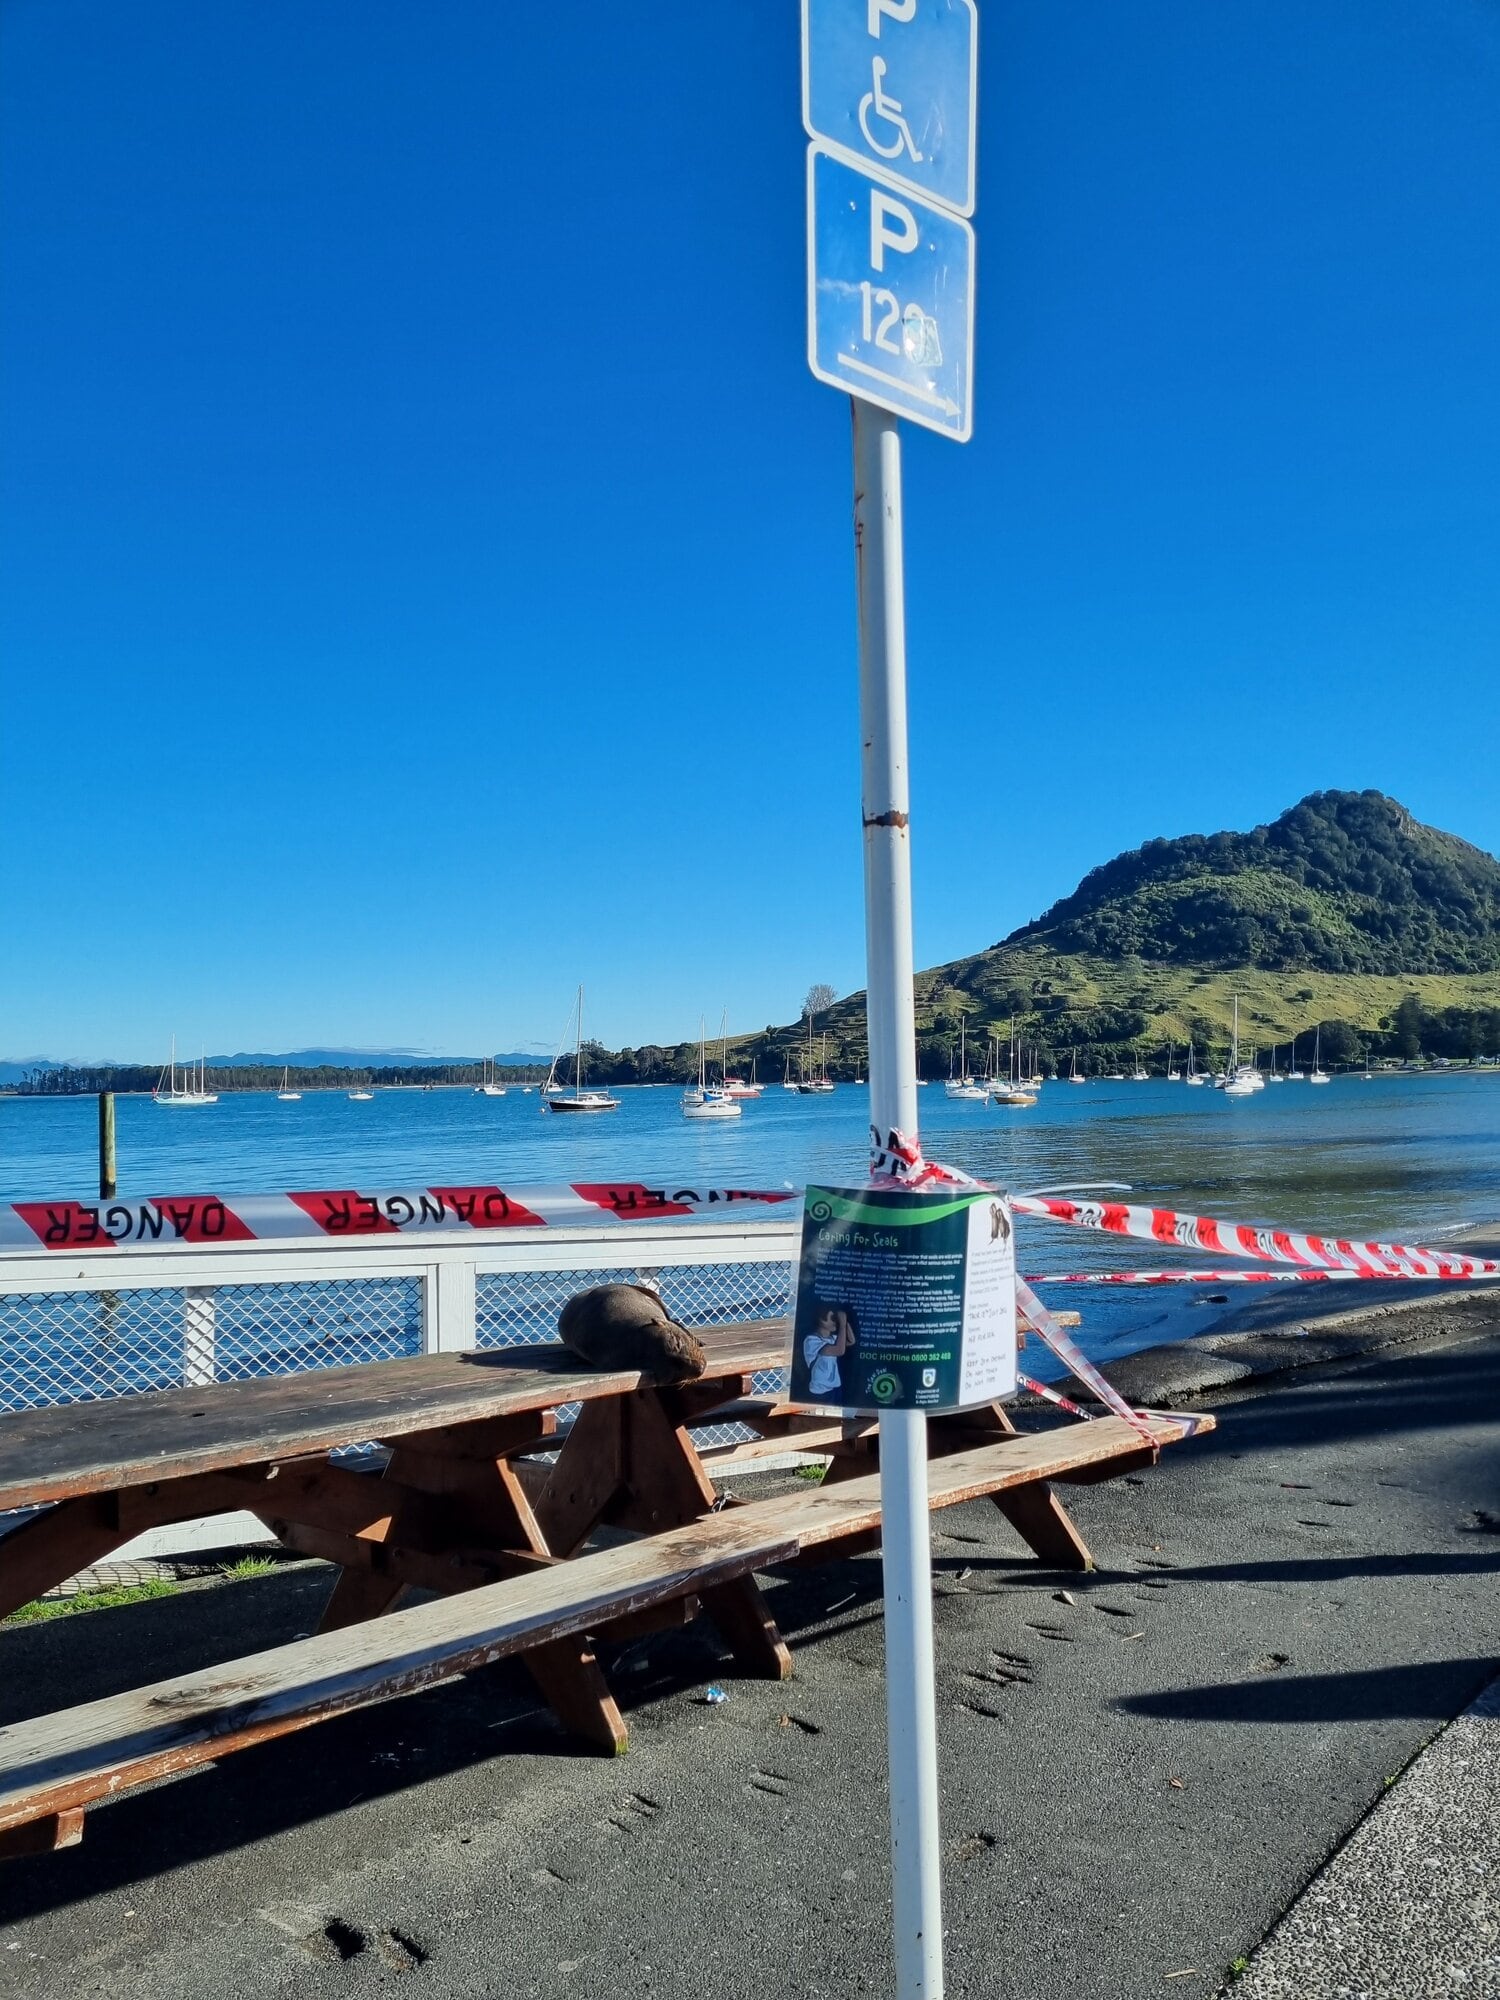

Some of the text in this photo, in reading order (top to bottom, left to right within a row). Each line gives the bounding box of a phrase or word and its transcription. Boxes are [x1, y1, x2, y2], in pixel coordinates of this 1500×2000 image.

[871, 188, 919, 273] P
[45, 1202, 226, 1243] DANGER
[322, 1193, 509, 1231] DANGER
[818, 1228, 850, 1247] Caring
[873, 1232, 899, 1247] Seals
[859, 1352, 878, 1360] DOC
[879, 1353, 910, 1361] HOTline
